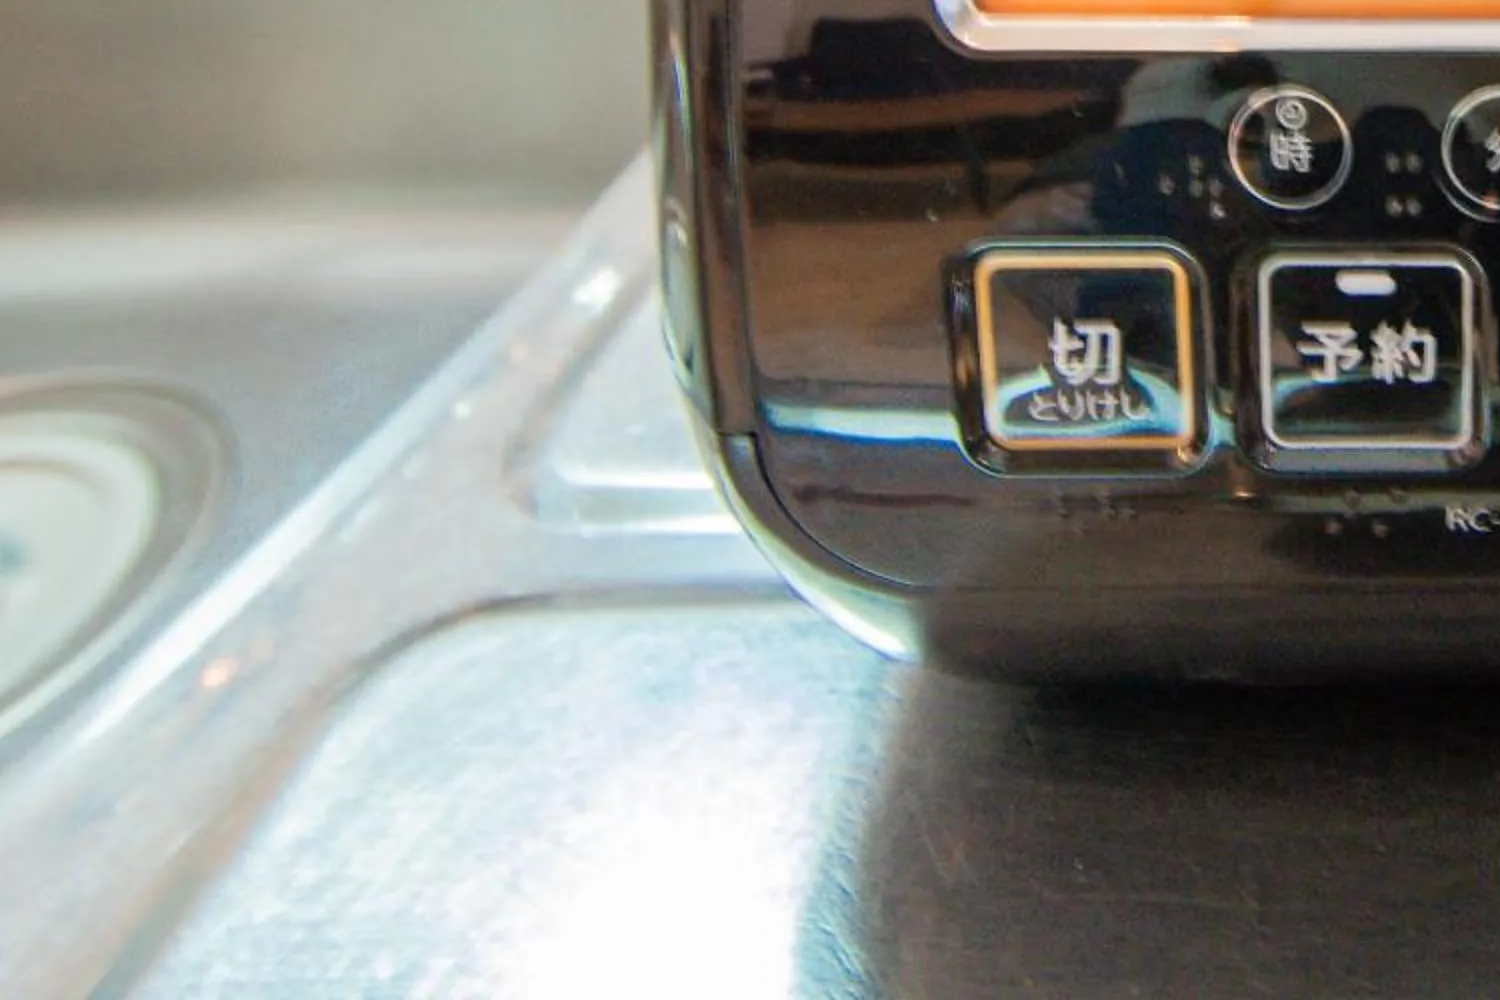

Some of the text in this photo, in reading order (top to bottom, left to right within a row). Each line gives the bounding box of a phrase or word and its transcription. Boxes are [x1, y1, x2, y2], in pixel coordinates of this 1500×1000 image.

[1269, 130, 1314, 173] 時
[1048, 316, 1124, 386] 切
[1297, 318, 1439, 385] 予約
[1027, 392, 1151, 422] とりけし
